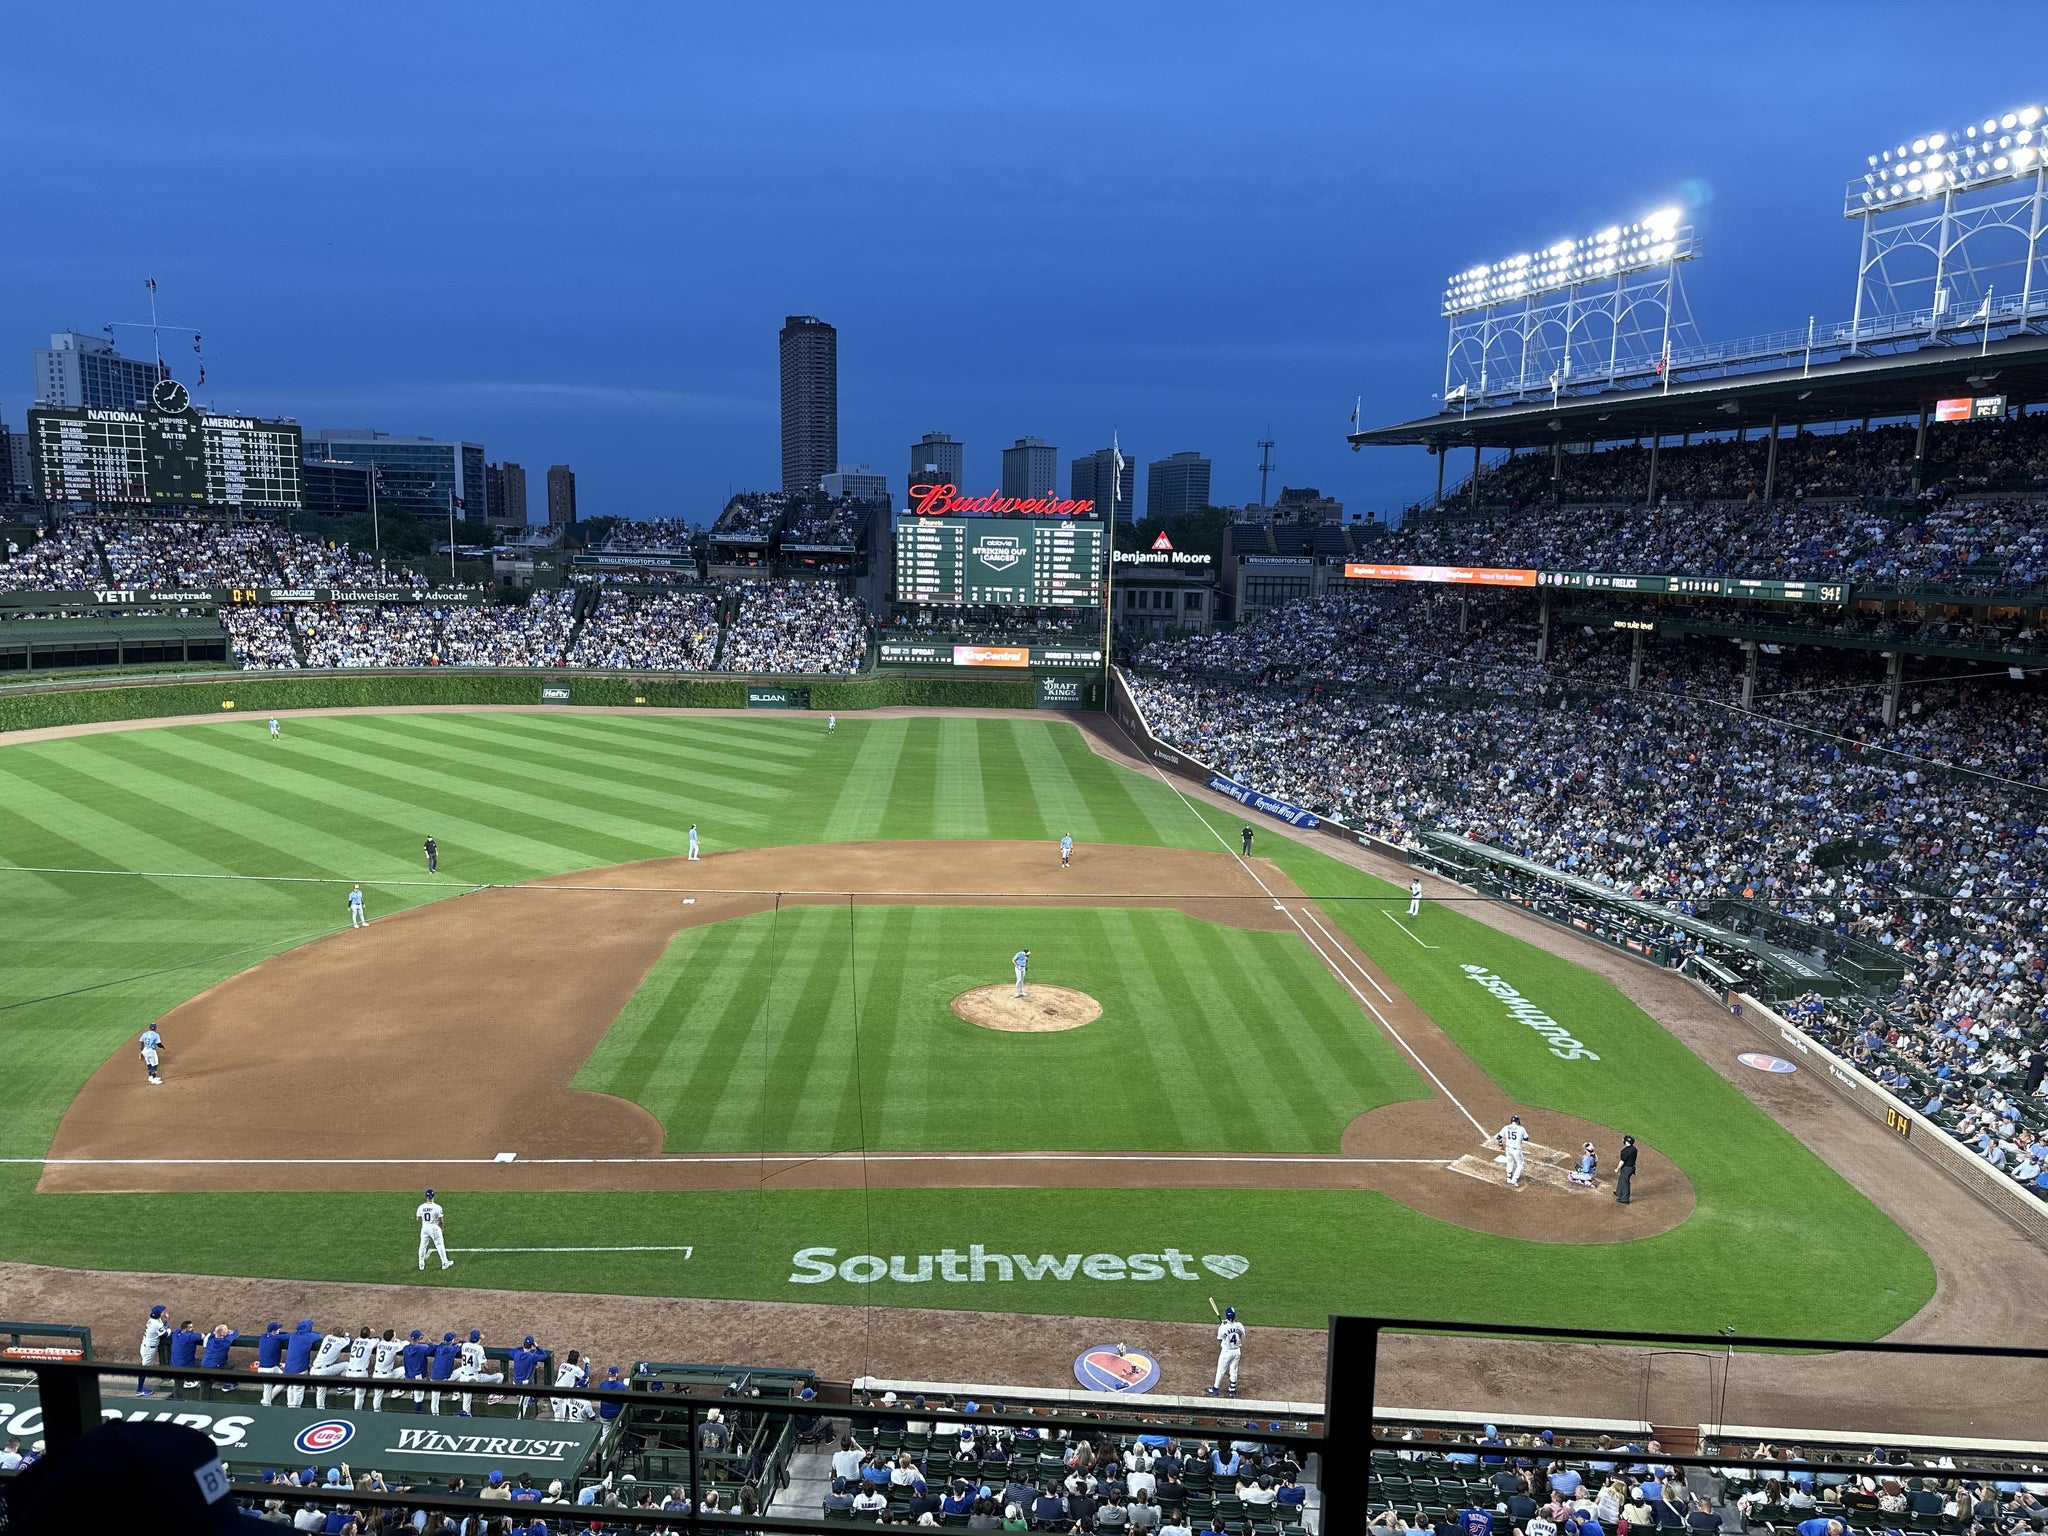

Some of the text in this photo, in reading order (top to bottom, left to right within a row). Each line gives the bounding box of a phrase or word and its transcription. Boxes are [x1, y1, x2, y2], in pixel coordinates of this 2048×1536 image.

[88, 410, 145, 422] NATIONAL
[159, 417, 188, 425] UMPIRES
[201, 417, 254, 429] AMERICAN
[162, 432, 187, 440] BATTER
[168, 440, 184, 450] 15
[909, 483, 1095, 515] Budweiser
[1011, 548, 1027, 556] OUT
[1112, 551, 1211, 564] Benjamin Moore
[598, 557, 671, 565] WRIGLEYROOFTOPS.COM
[1612, 578, 1638, 589] FRELICK
[94, 591, 135, 602] YETI
[158, 592, 212, 602] tastytrade
[233, 590, 256, 602] 0:14
[425, 592, 468, 600] Advocate
[972, 592, 978, 601] 2
[1005, 594, 1010, 602] 1
[1019, 594, 1025, 602] 2
[1820, 587, 1835, 600] 94
[1044, 682, 1078, 690] DRAFT
[545, 690, 568, 698] Hefty
[1210, 779, 1242, 800] Reynolds Wrap
[1254, 797, 1295, 822] Reynolds Wrap
[1466, 974, 1600, 1060] Southwest
[1507, 1131, 1517, 1140] 15
[424, 1213, 430, 1221] 0
[788, 1244, 1200, 1283] Southwest
[1230, 1335, 1237, 1345] 4
[322, 1343, 332, 1354] 8
[352, 1346, 364, 1358] 20
[378, 1350, 386, 1362] 3
[557, 1371, 566, 1382] 7
[572, 1406, 578, 1418] 2
[398, 1429, 567, 1456] WINTRUST
[1410, 1452, 1423, 1462] 14
[1469, 1524, 1486, 1536] 27
